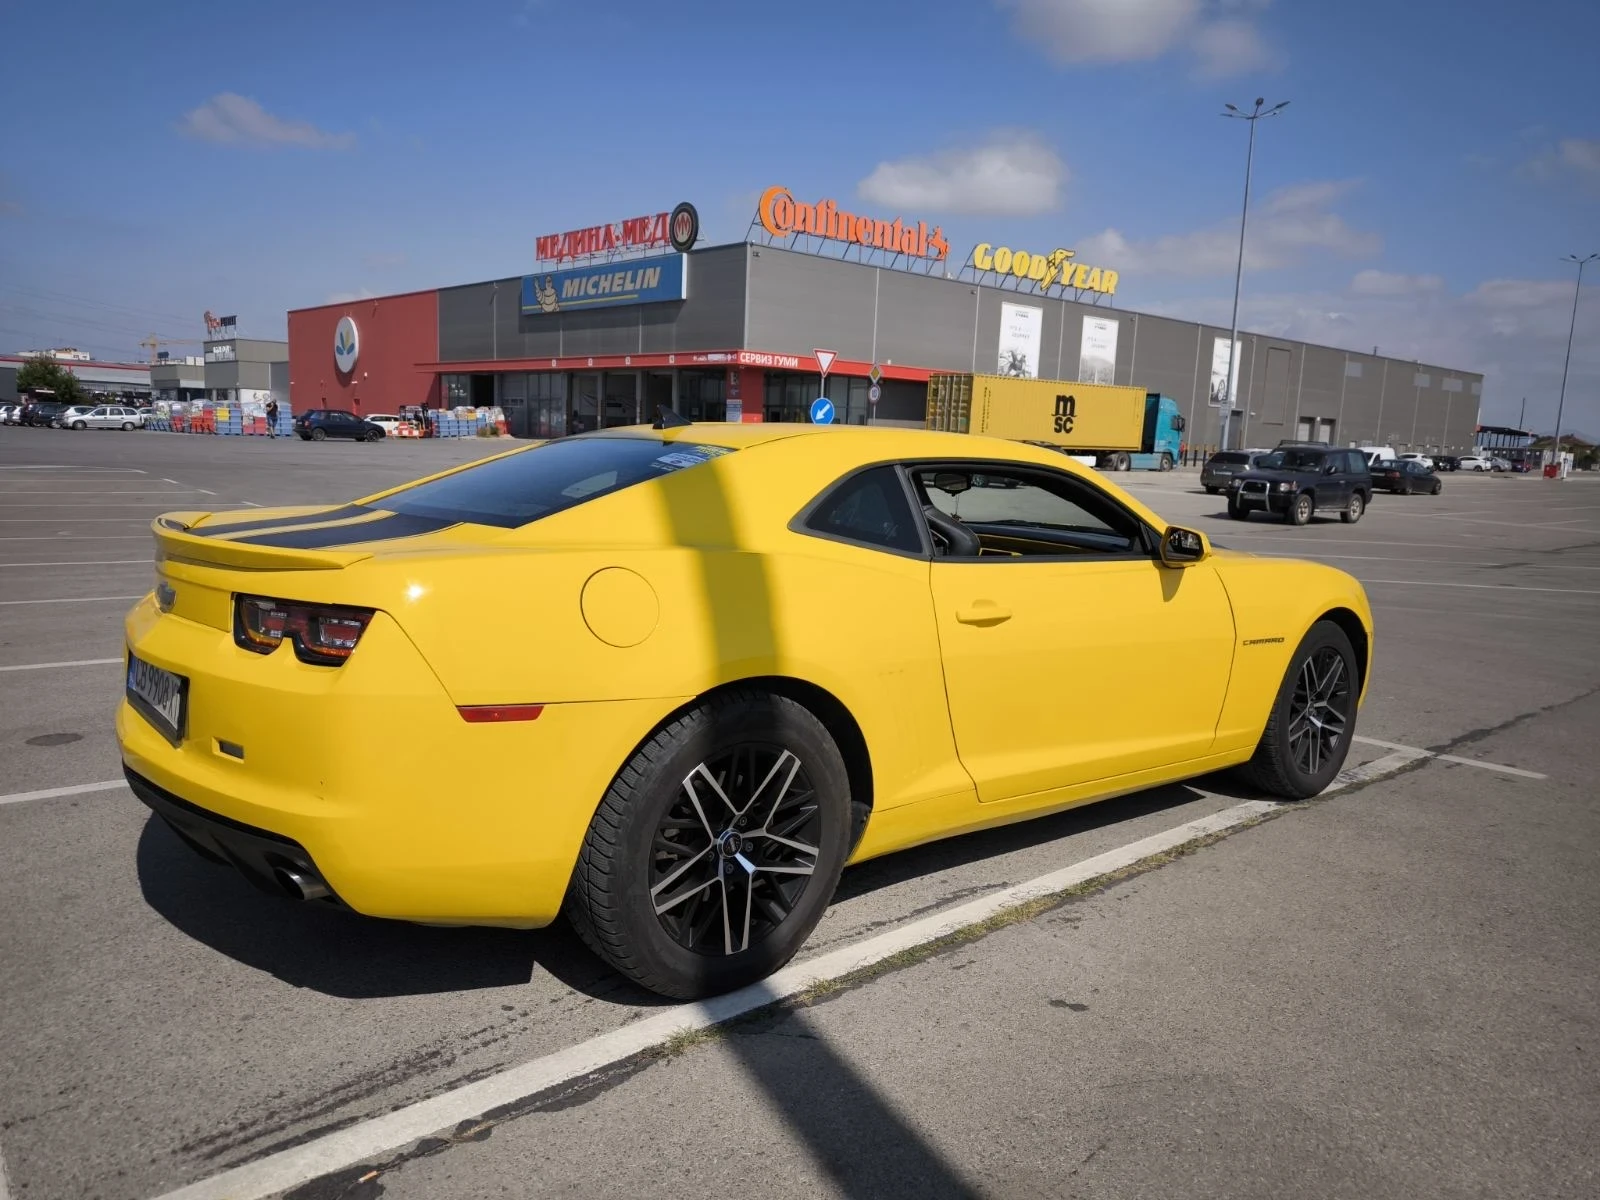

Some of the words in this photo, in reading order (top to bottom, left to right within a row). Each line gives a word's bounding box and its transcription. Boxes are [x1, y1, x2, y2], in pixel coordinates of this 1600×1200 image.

[535, 212, 671, 261] МЕДИНА-МЕД
[759, 185, 929, 257] Continental
[561, 265, 662, 299] MICHELIN
[740, 352, 773, 365] СЕРВИЗ
[774, 355, 799, 368] ГУМИ
[1242, 637, 1285, 646] CAMARO
